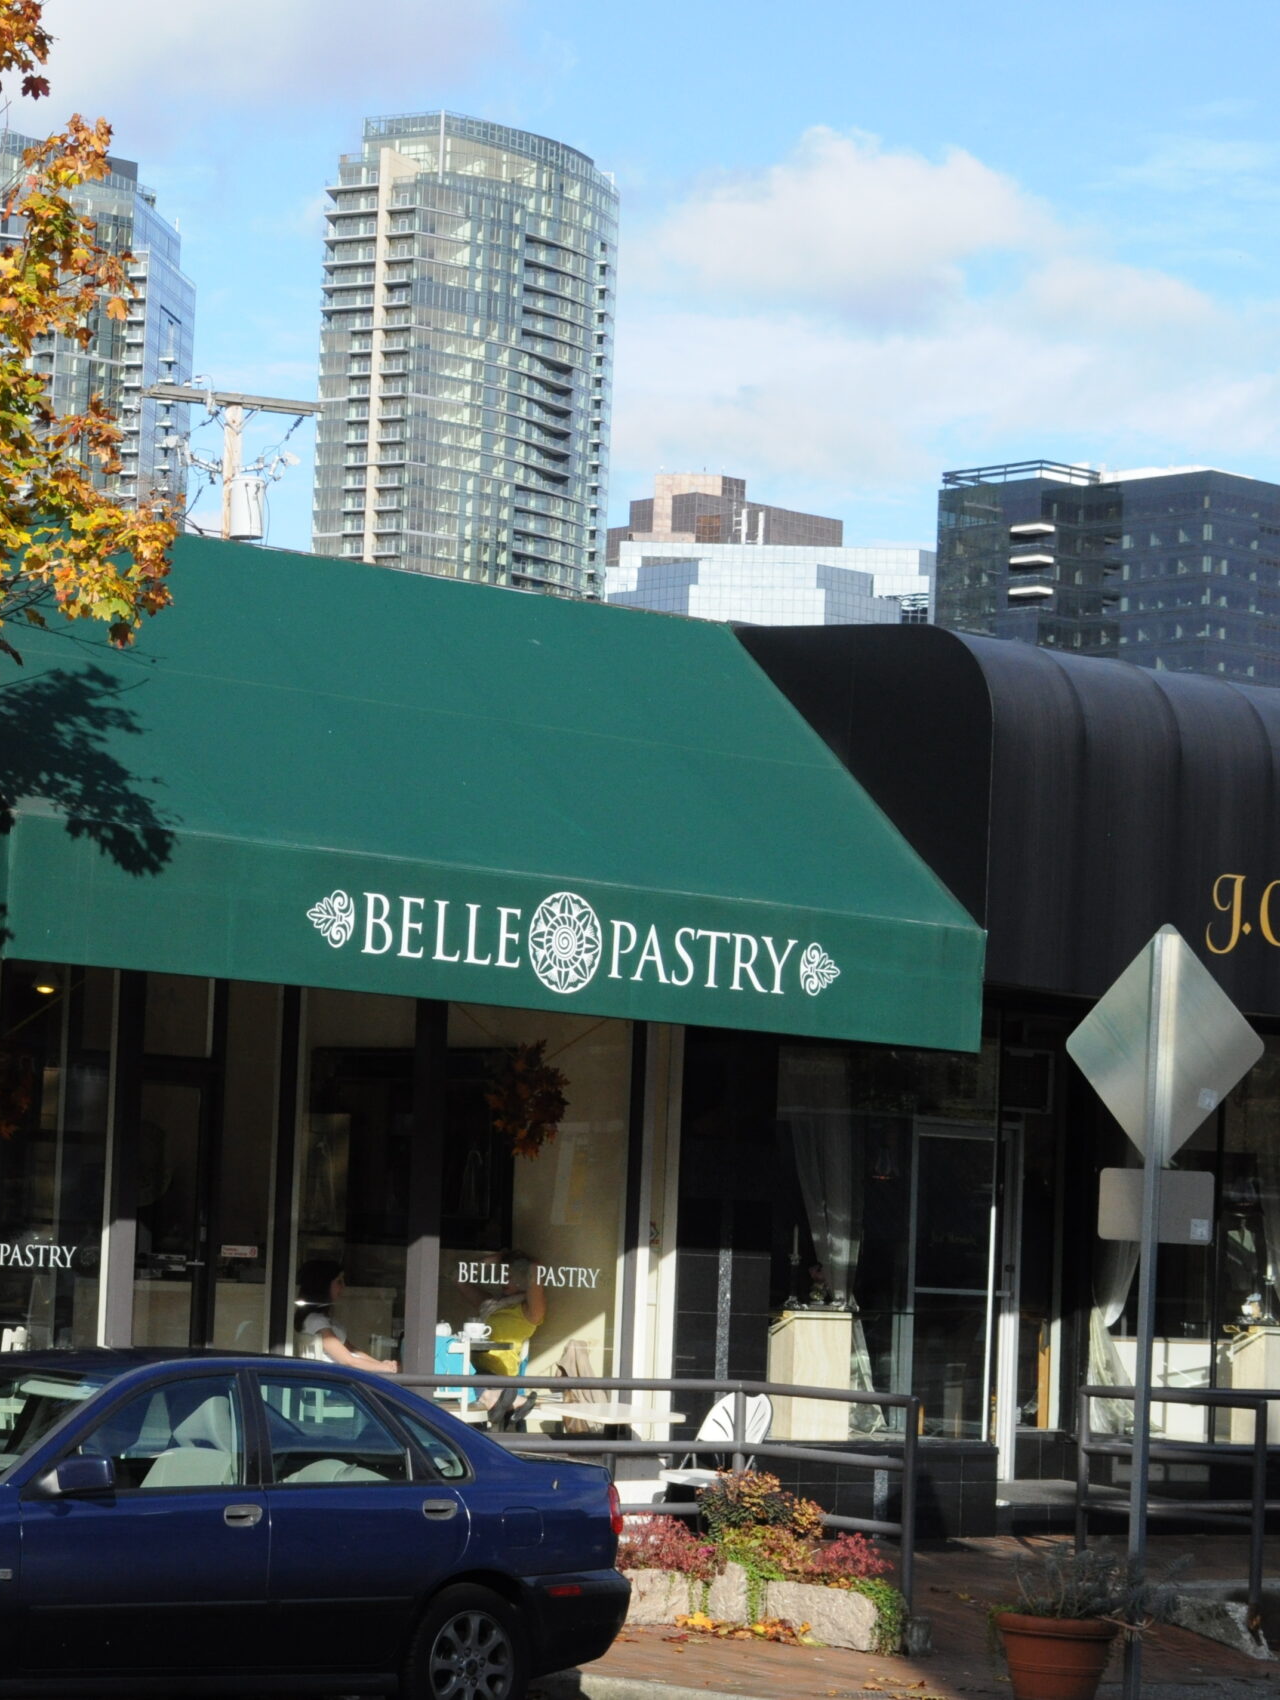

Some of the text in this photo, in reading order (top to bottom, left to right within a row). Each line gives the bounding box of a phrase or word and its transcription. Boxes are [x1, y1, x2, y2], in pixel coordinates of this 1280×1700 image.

[361, 891, 798, 995] BELLE PASTRY
[458, 1262, 600, 1289] BELLE PASTRY
